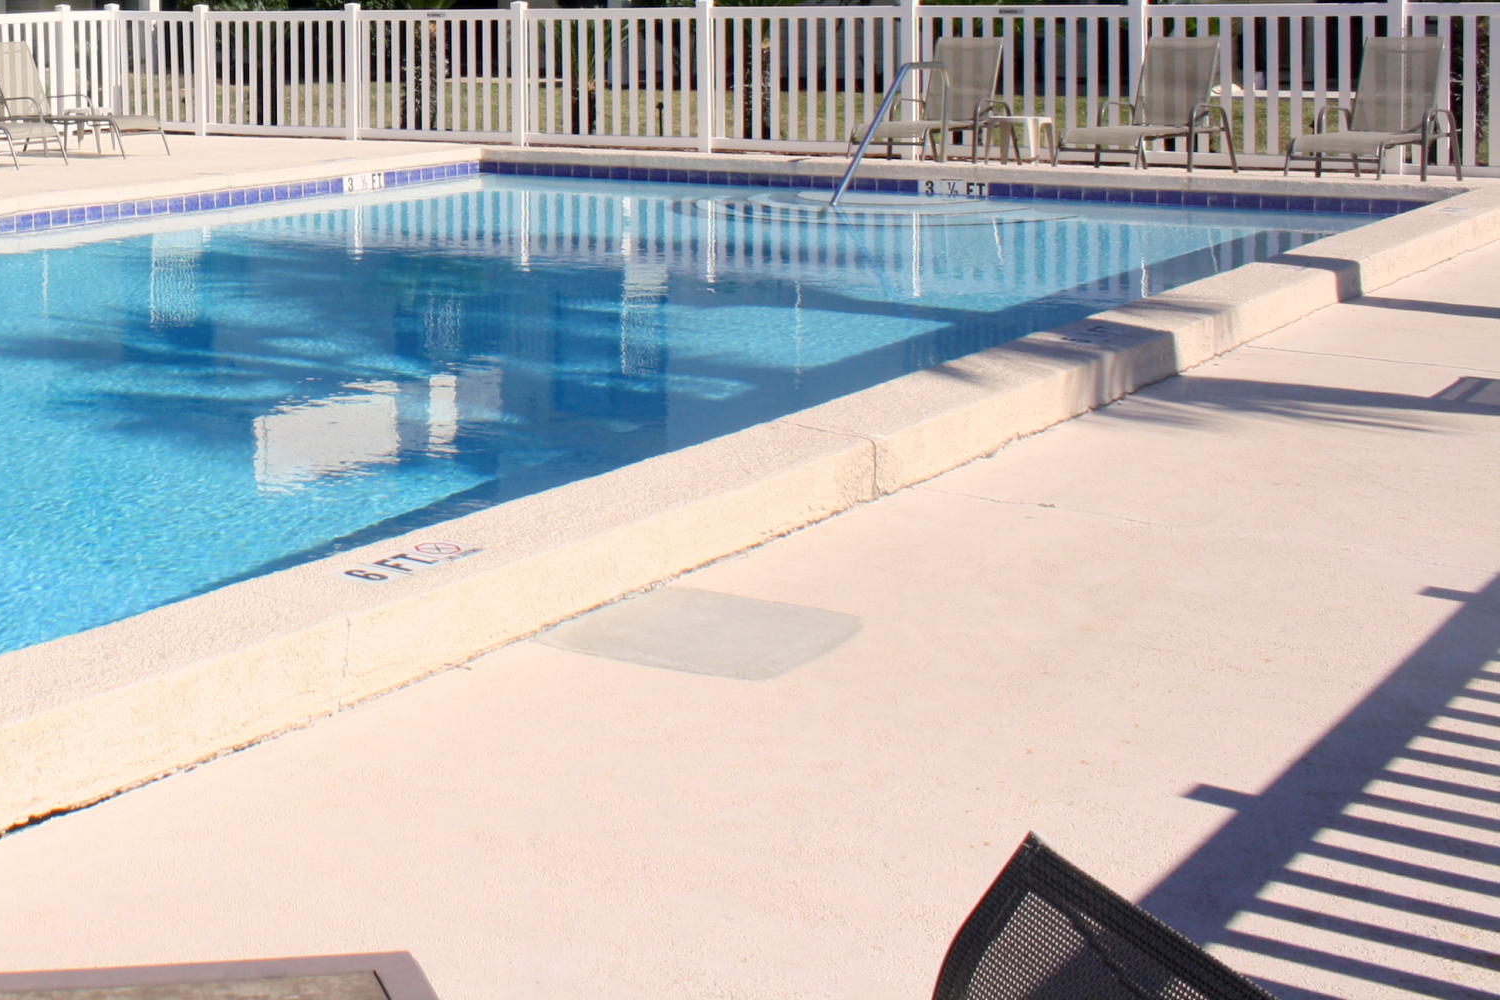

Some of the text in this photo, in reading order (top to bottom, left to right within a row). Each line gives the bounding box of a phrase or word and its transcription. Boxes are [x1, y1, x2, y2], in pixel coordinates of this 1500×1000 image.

[347, 177, 354, 192] 3
[371, 173, 382, 190] FT
[925, 181, 934, 195] 3
[966, 183, 985, 196] FT
[344, 569, 388, 581] 6
[372, 553, 439, 572] FT
